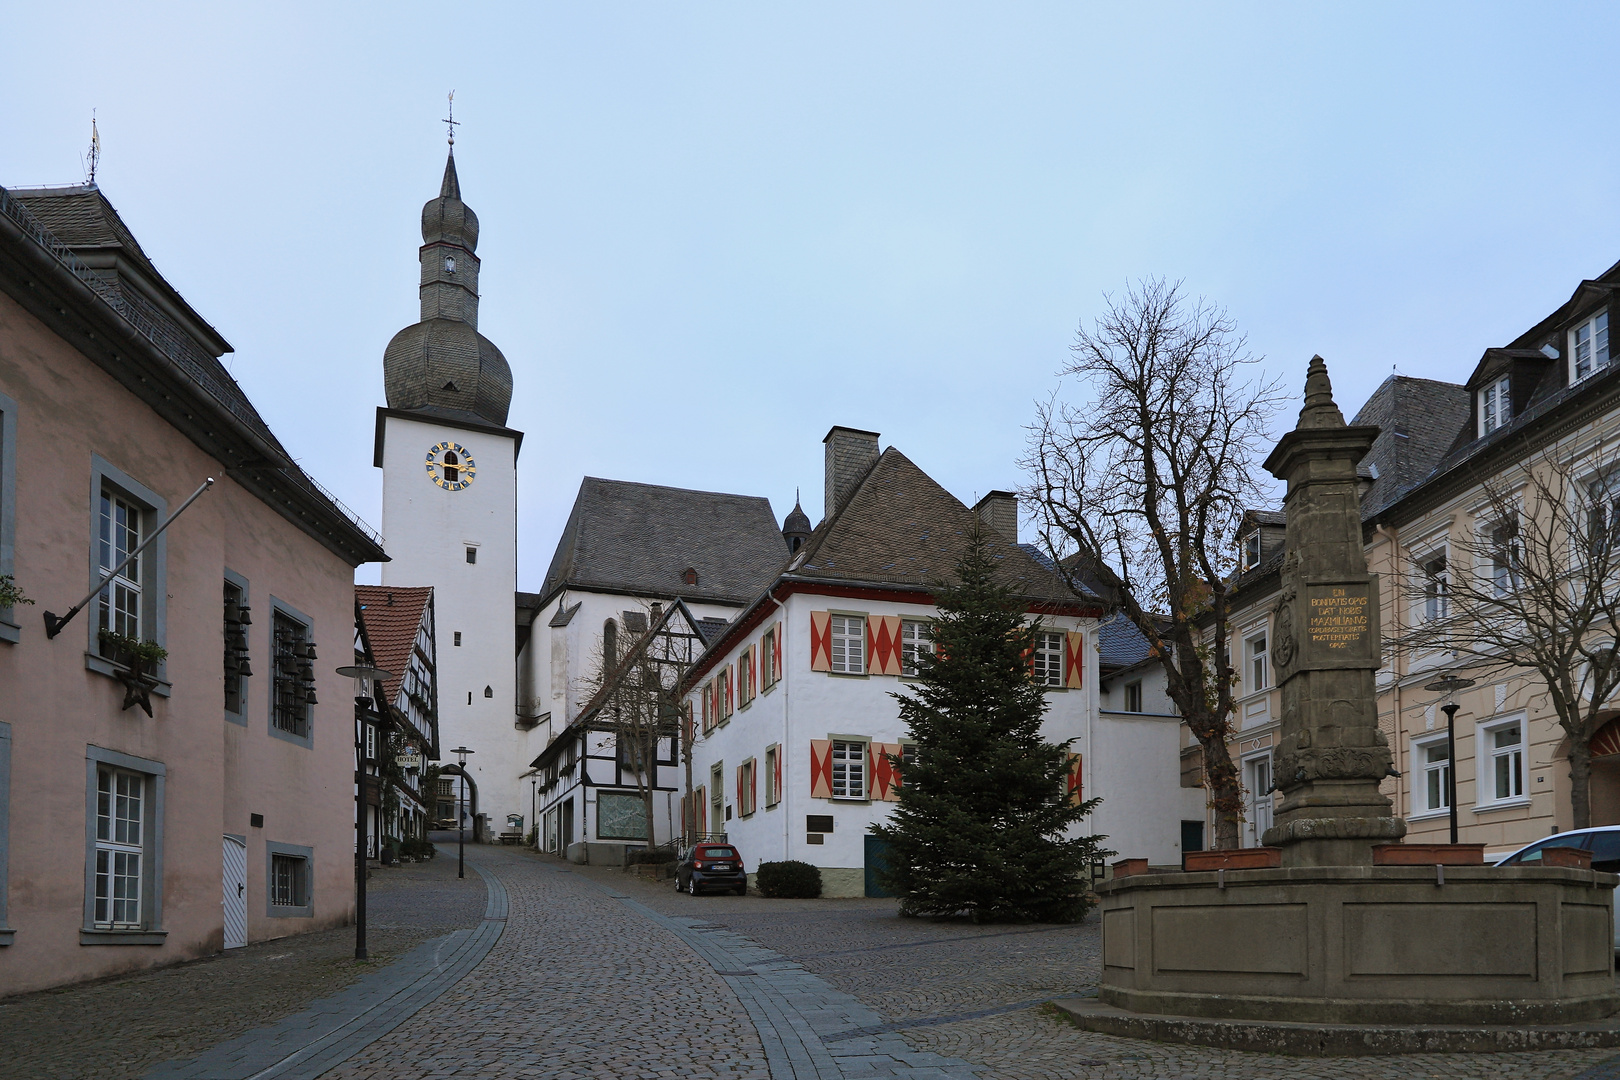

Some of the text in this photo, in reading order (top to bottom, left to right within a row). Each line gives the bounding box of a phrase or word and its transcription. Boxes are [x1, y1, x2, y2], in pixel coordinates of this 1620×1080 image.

[1333, 589, 1345, 597] EN
[1348, 597, 1367, 605] OPVS
[1318, 607, 1336, 615] DAT
